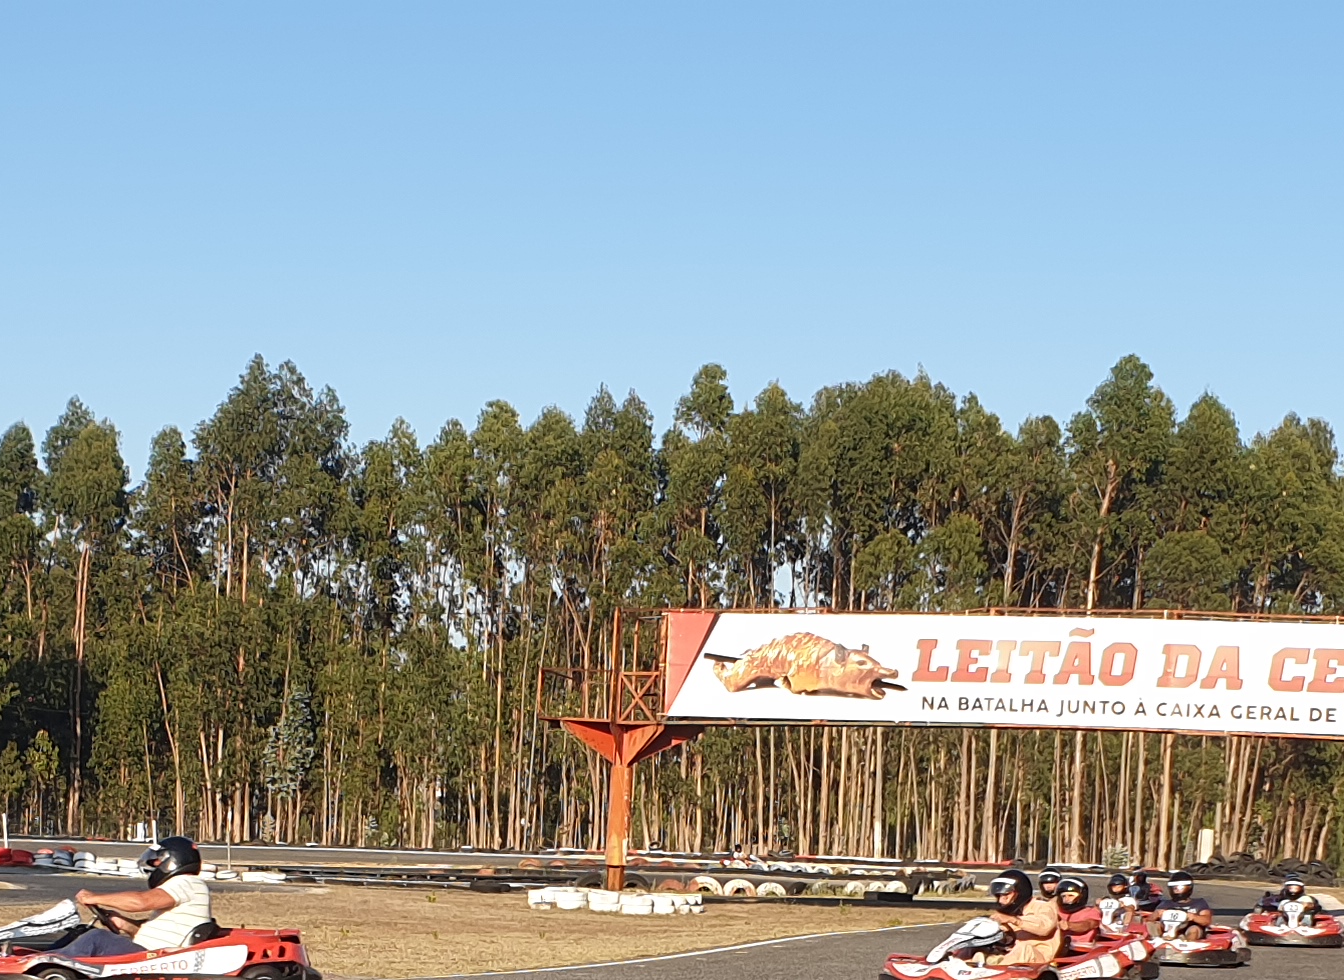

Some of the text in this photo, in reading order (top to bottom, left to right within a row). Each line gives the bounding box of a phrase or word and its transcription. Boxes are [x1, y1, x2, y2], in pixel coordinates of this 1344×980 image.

[911, 627, 1138, 687] LEITÃO
[1156, 643, 1243, 690] DA
[921, 696, 949, 711] NA
[958, 696, 1049, 713] BATALHA
[1056, 699, 1126, 717] JUNTO
[1134, 697, 1147, 716] À
[1156, 701, 1221, 719] CAIXA
[1230, 704, 1300, 721] GERAL
[1309, 707, 1337, 723] DE
